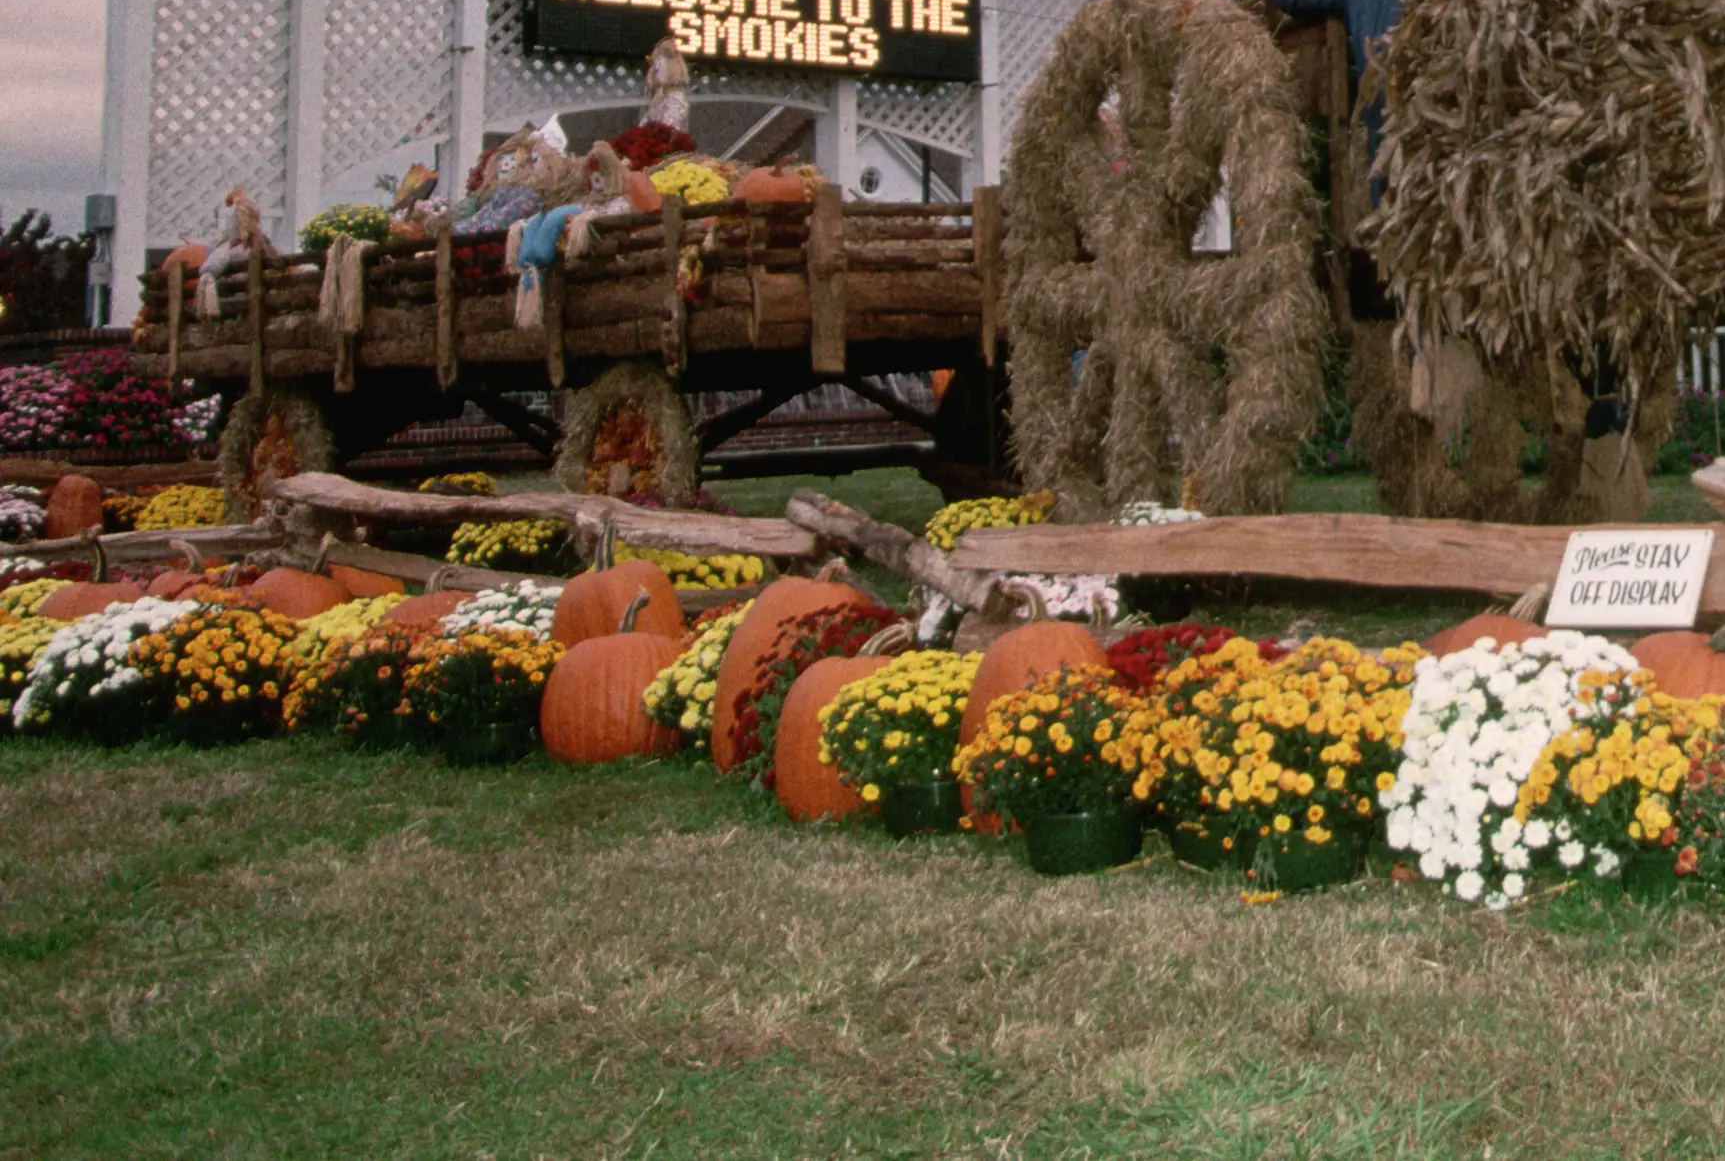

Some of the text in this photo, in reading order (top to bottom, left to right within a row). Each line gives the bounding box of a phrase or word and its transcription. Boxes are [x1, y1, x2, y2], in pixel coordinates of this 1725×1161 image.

[668, 10, 881, 67] SMOKIES
[1572, 541, 1691, 574] Please STAY
[1570, 580, 1688, 606] OFF DISPLAY
